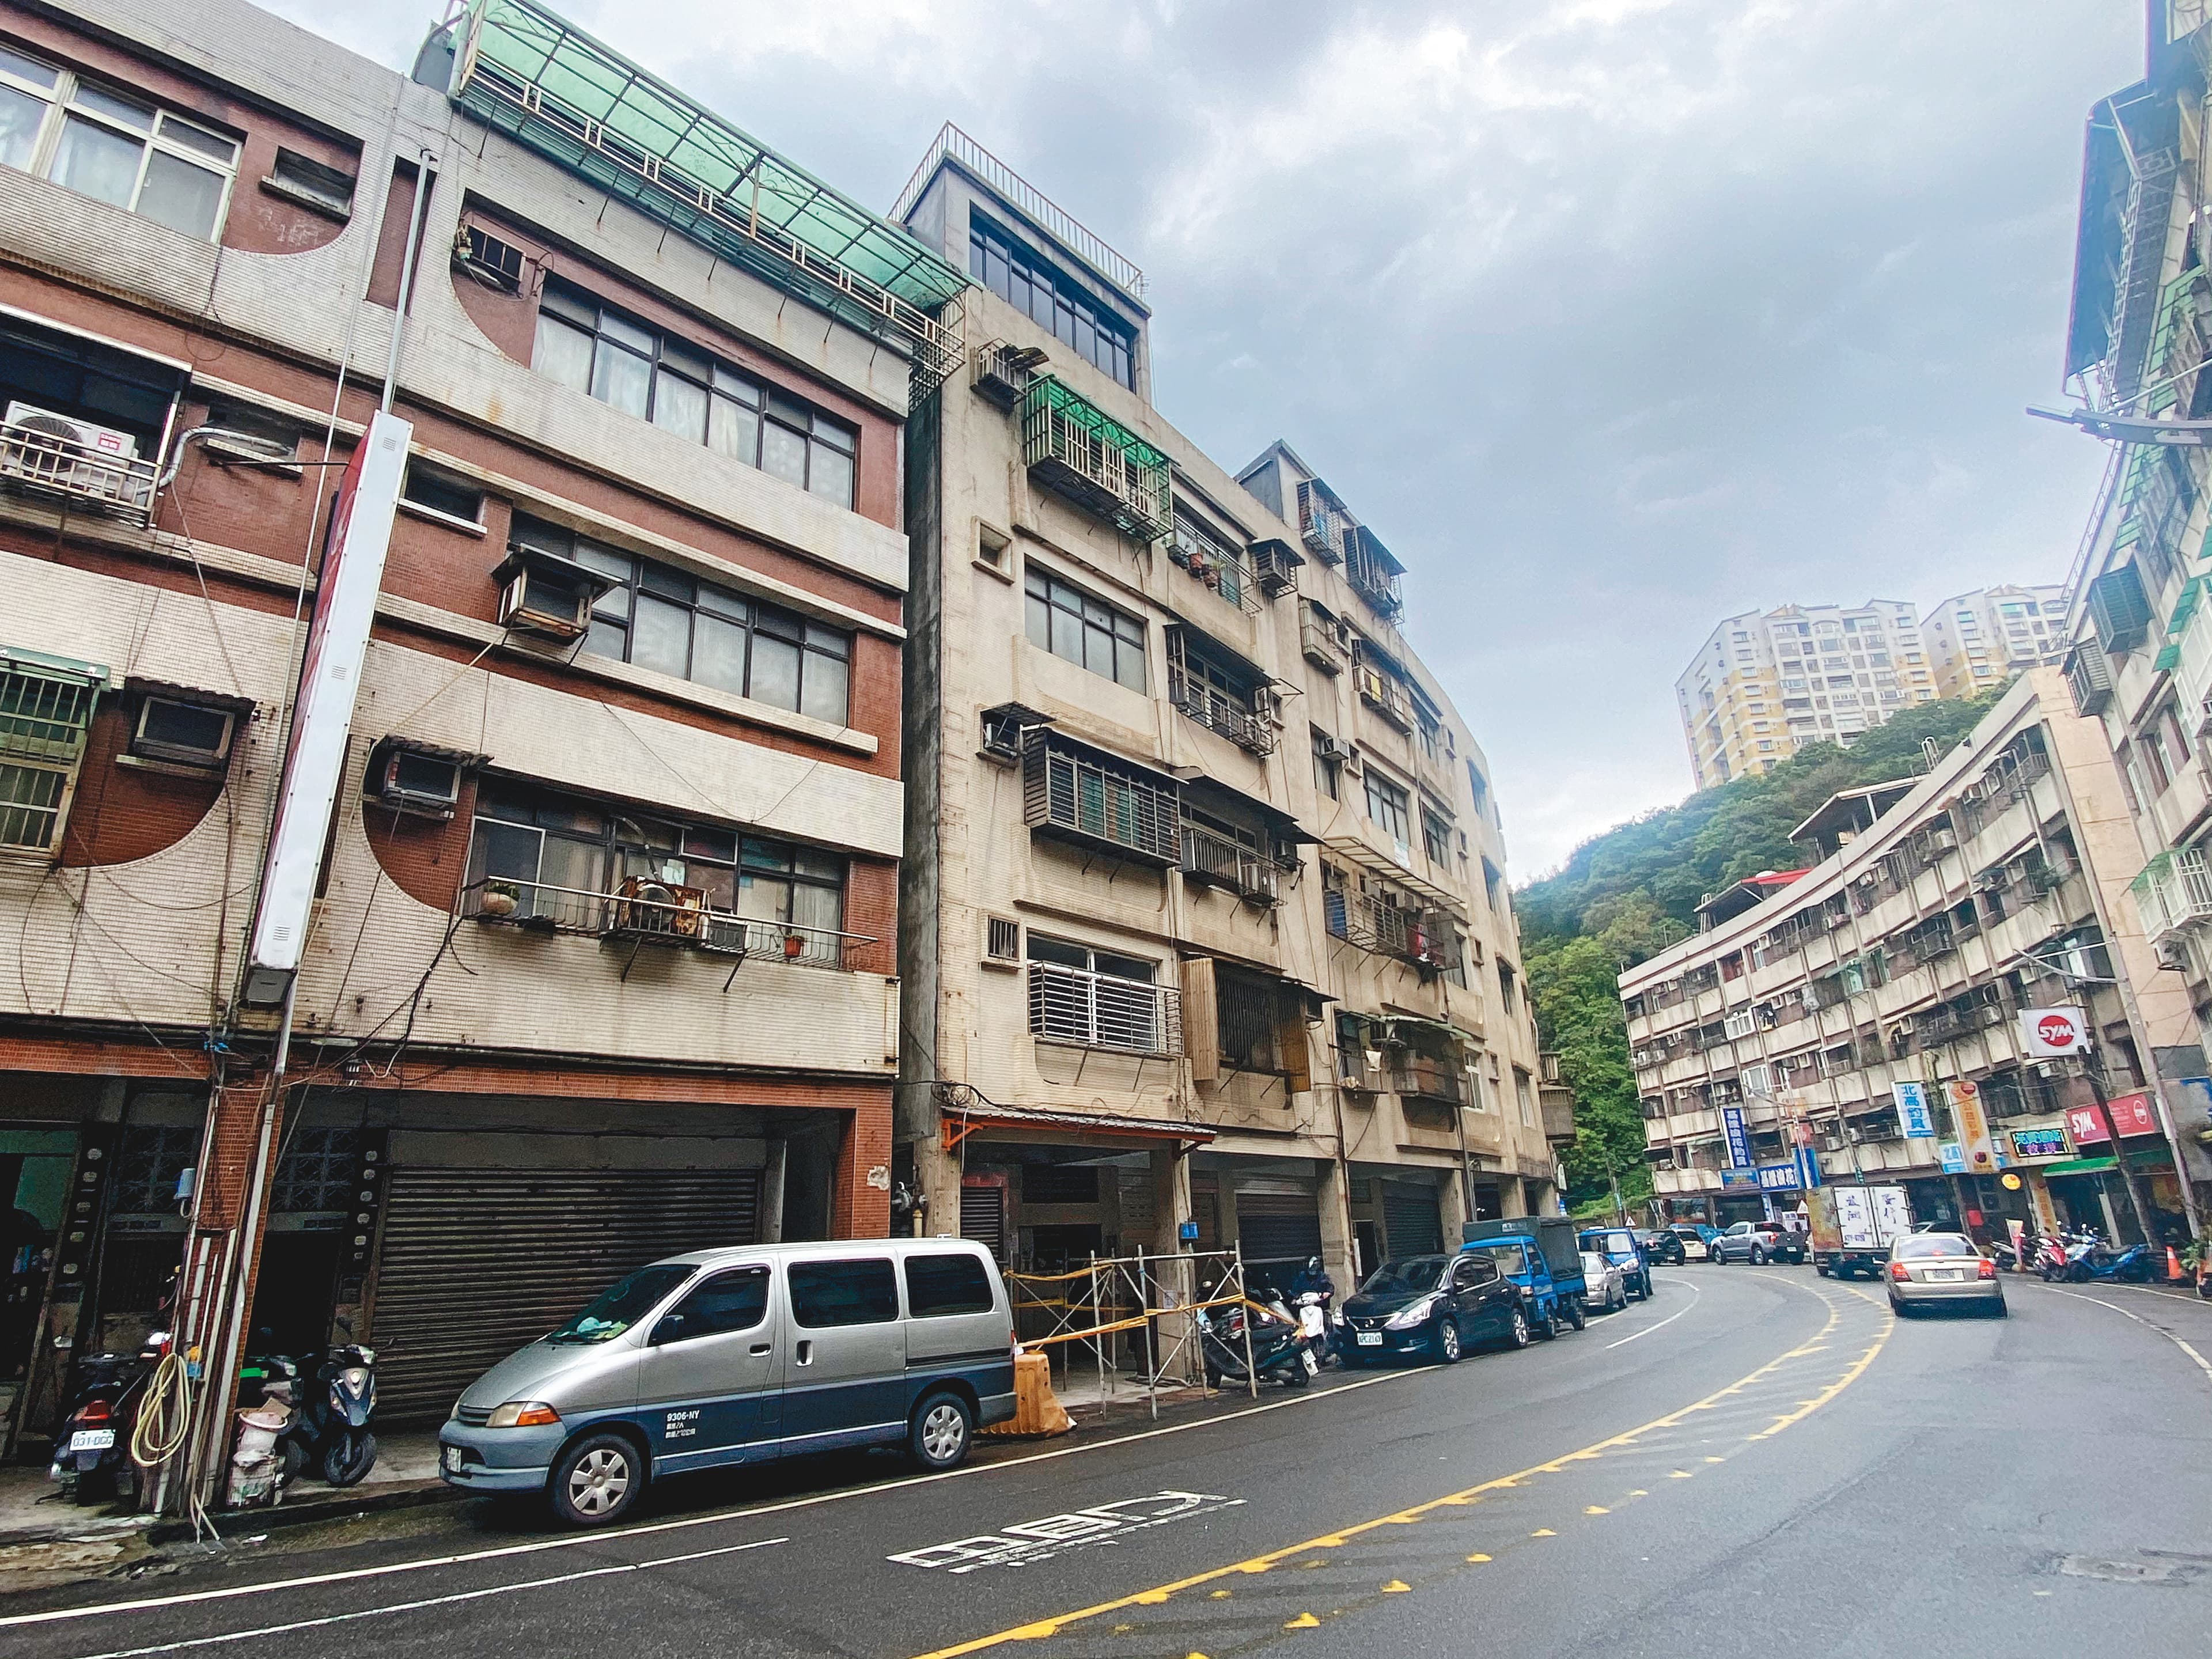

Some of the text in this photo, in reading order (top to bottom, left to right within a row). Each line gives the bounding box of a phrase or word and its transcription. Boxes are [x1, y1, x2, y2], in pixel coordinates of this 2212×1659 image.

[2040, 1025, 2074, 1041] SYM
[2071, 1111, 2096, 1138] SYM
[667, 1410, 699, 1422] 9306-NY
